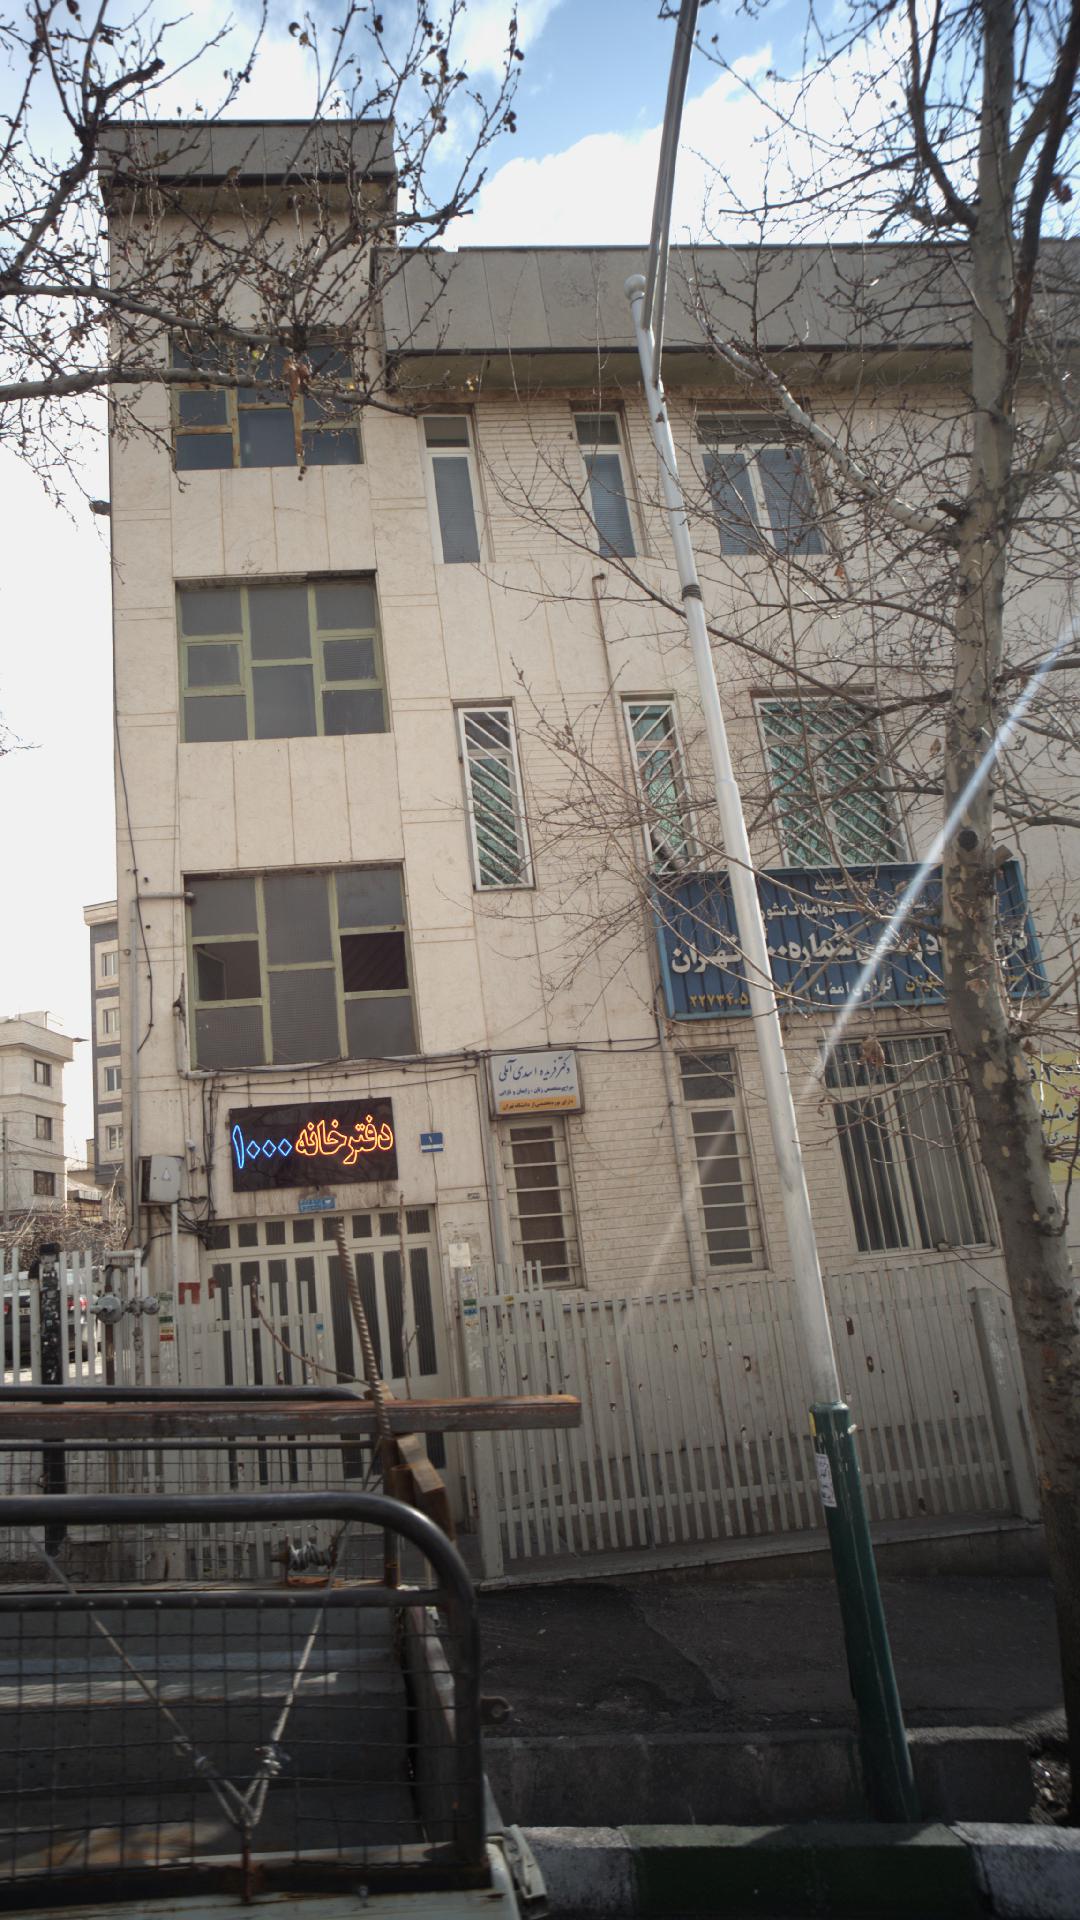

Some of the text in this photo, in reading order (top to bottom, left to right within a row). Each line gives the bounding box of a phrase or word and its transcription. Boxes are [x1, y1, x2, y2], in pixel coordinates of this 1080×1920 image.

[689, 992, 750, 1008] ۲۲۷۳۴۰۵
[232, 1114, 394, 1169] دفترخانه ۱۰۰۰
